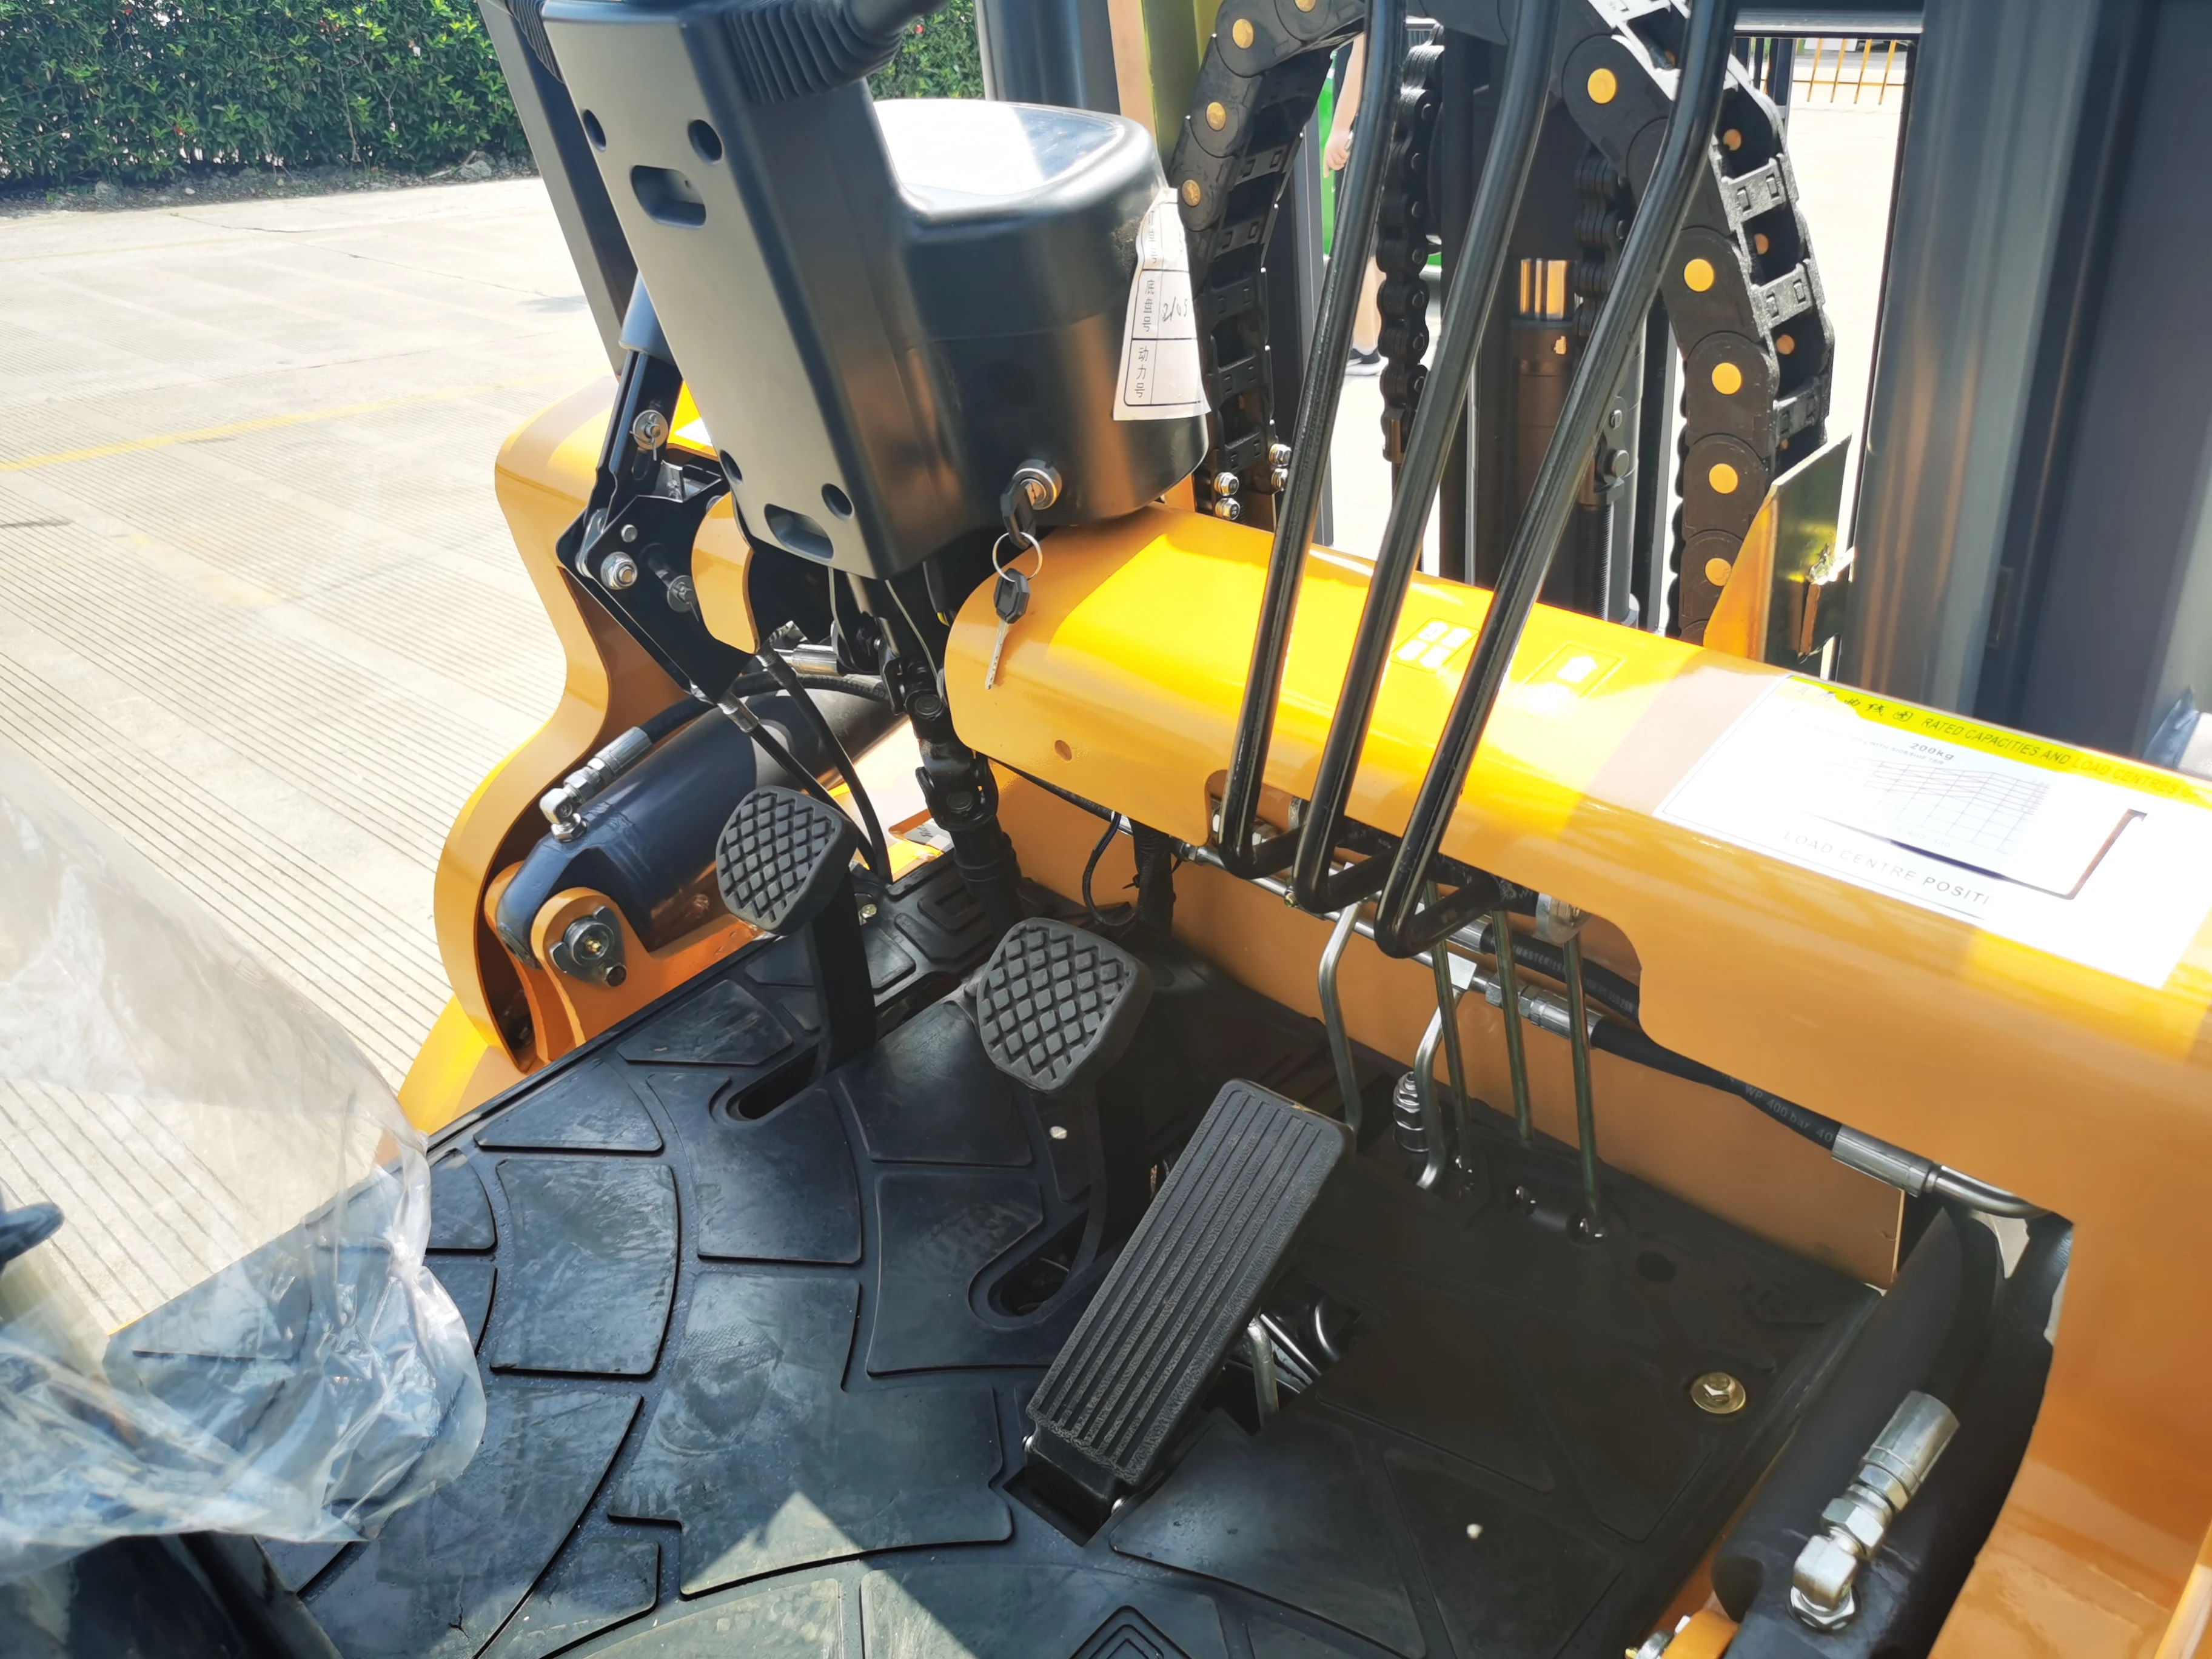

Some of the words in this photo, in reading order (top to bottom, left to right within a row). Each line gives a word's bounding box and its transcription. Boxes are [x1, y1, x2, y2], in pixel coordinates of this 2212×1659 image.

[1142, 279, 1155, 332] 底盘号
[1134, 346, 1149, 398] 动力号
[1869, 740, 1889, 749] WITH
[1920, 717, 1965, 736] RATED
[1965, 728, 2042, 758] CAPACITIES
[2038, 749, 2071, 765] AND
[2072, 756, 2111, 776] LOAD
[2112, 769, 2179, 796] CENTRES
[1783, 831, 1833, 854] LOAD
[1840, 850, 1917, 882] CENTRE
[1922, 876, 1994, 907] POSITI
[1744, 1084, 1764, 1099] WP
